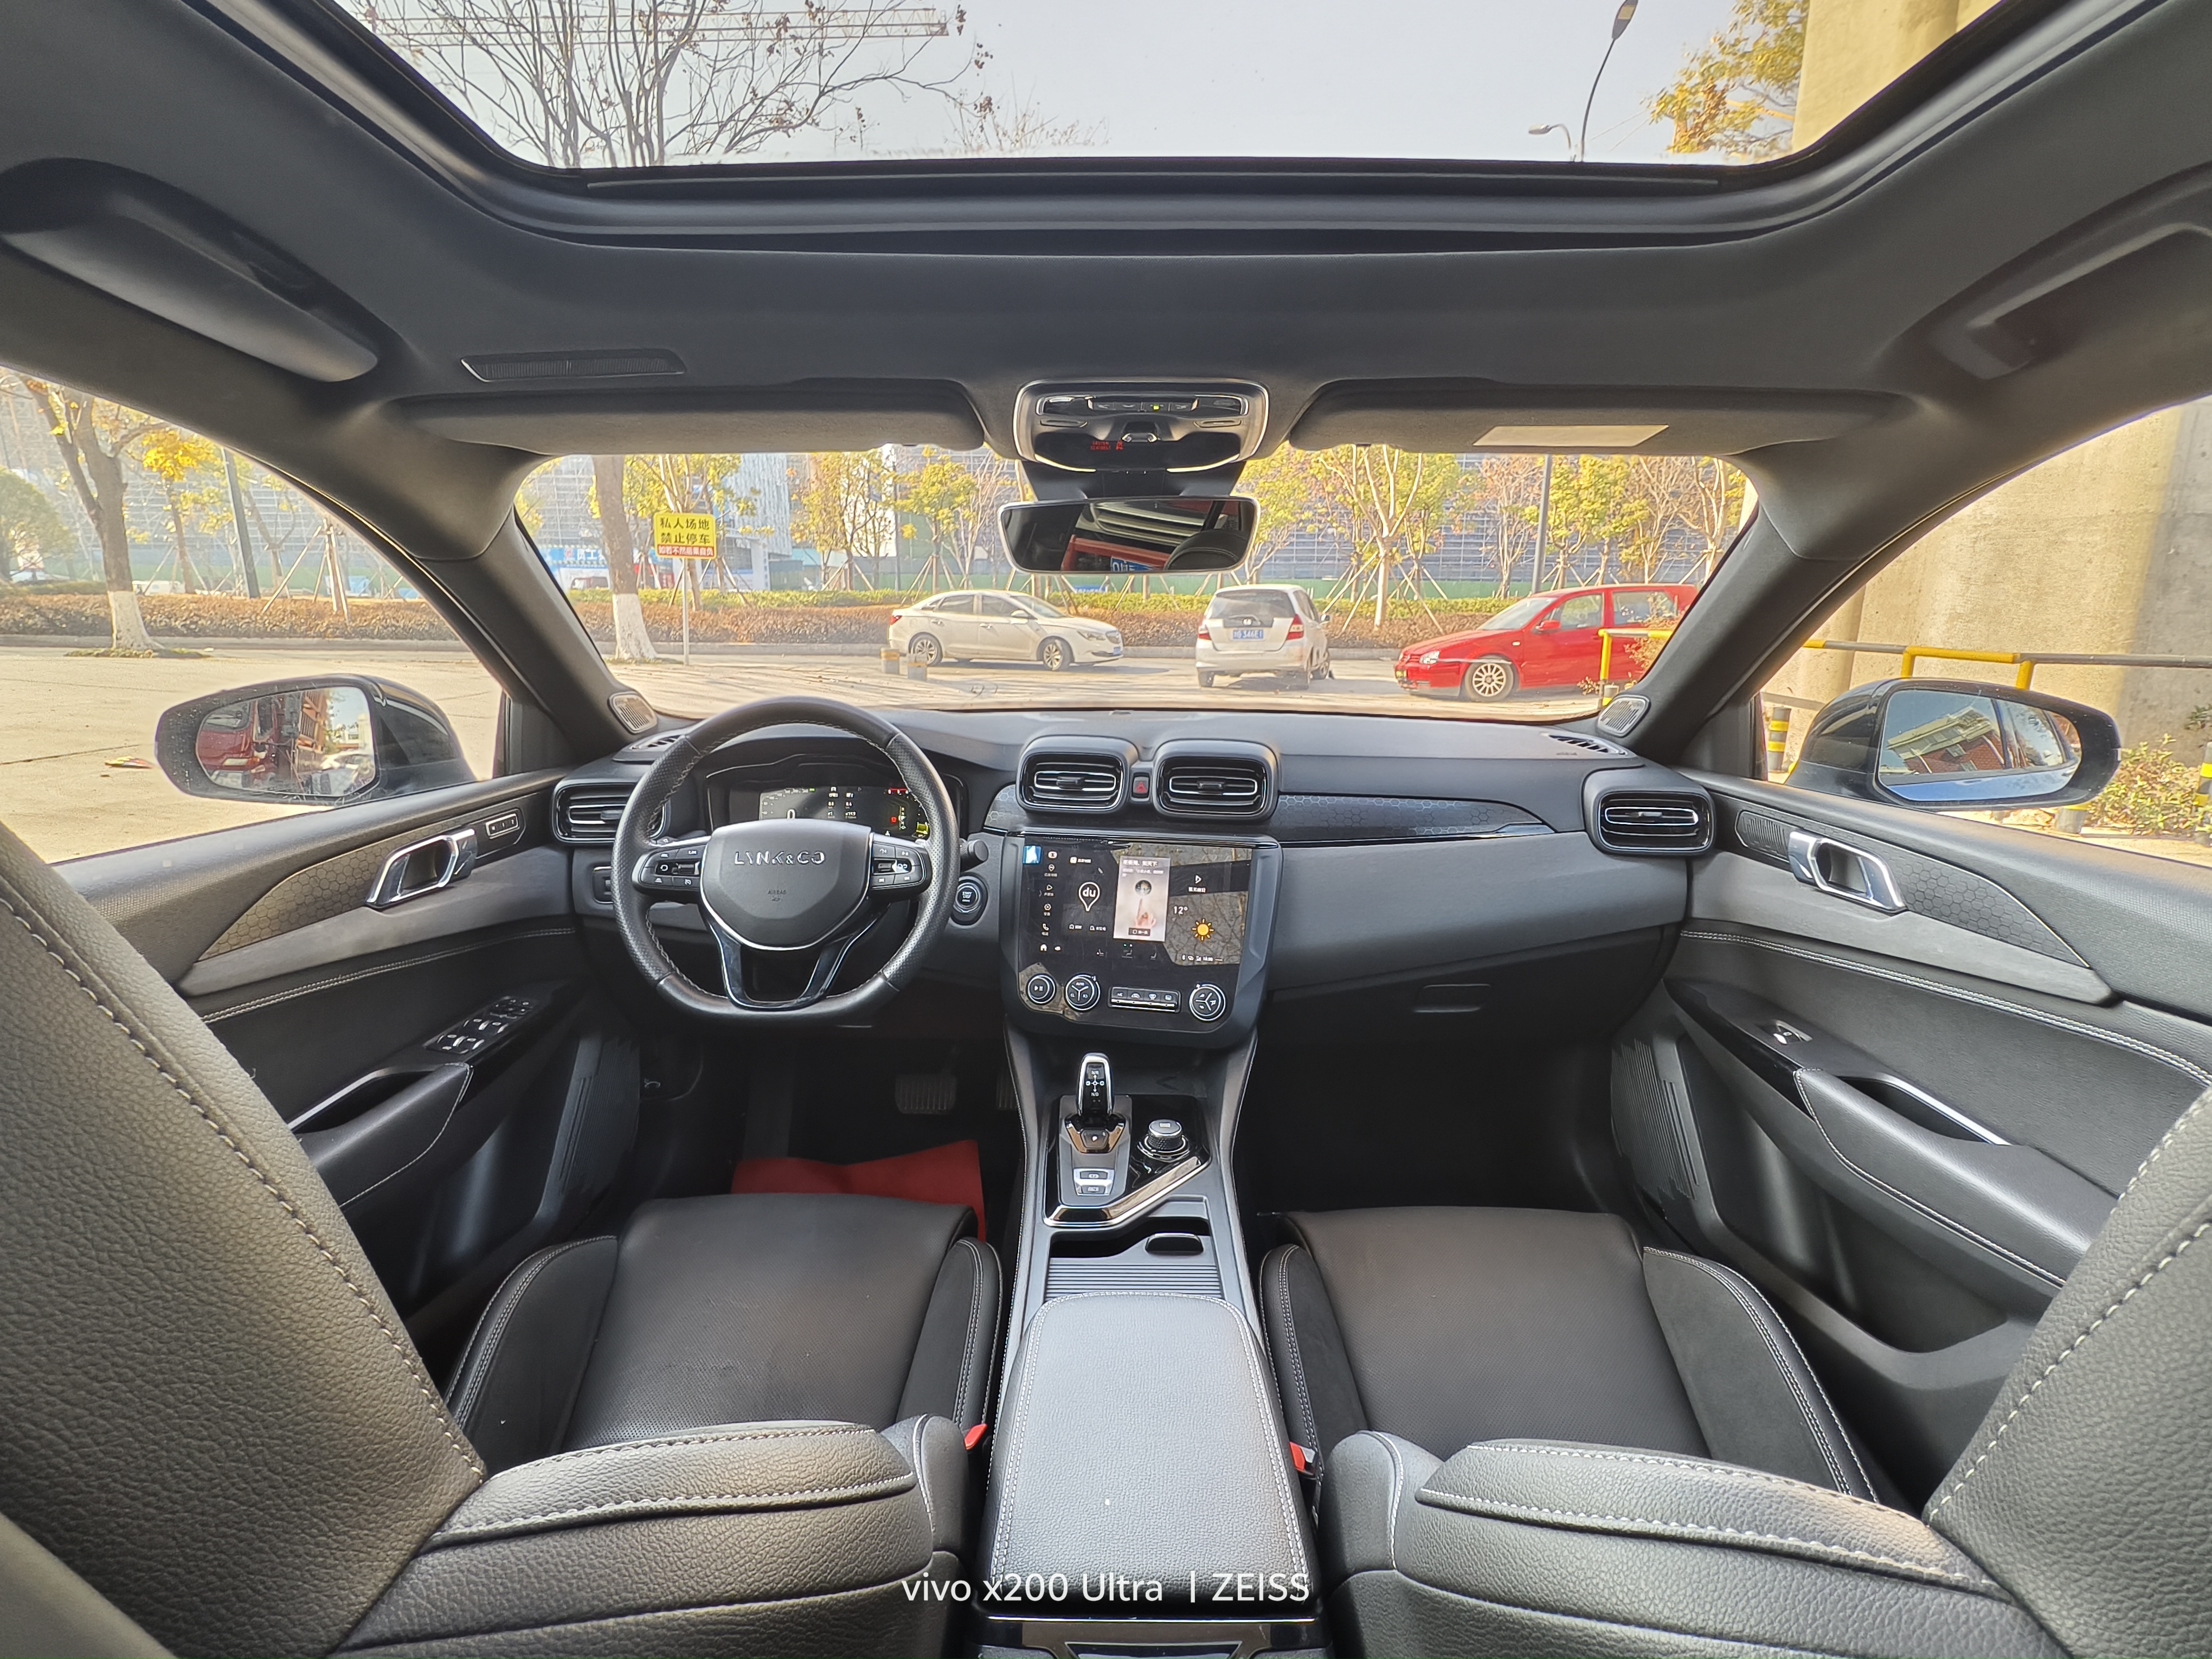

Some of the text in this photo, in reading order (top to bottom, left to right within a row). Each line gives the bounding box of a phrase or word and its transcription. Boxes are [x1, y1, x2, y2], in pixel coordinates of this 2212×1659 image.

[660, 517, 710, 530] 私人场地
[660, 532, 711, 545] 禁止停车
[734, 851, 825, 865] LYNK&CO
[1082, 887, 1096, 897] du
[1173, 905, 1188, 915] 12°
